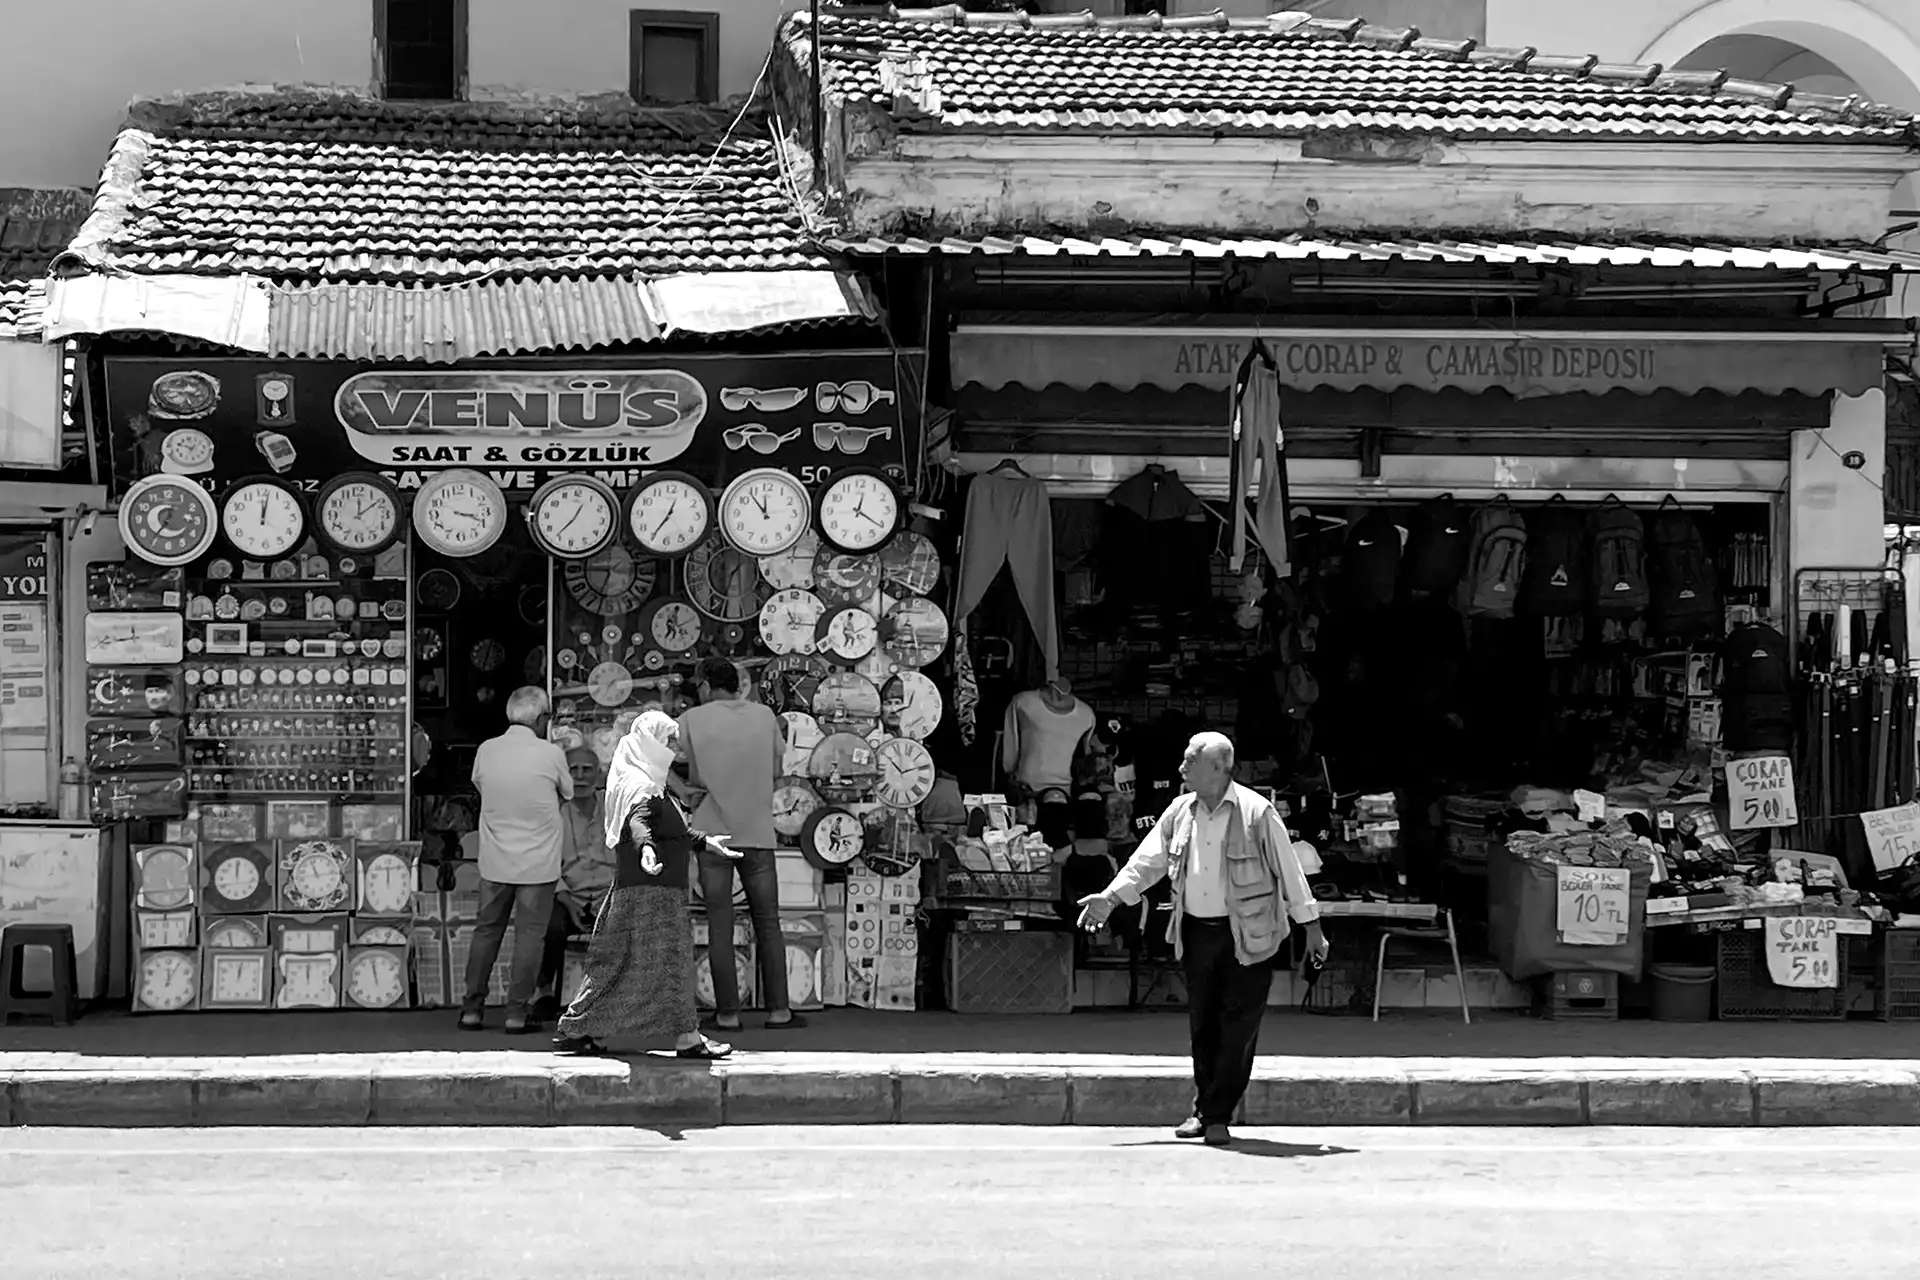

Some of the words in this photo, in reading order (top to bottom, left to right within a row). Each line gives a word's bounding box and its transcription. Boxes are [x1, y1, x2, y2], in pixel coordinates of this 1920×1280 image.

[1175, 343, 1278, 374] ATAK
[1286, 344, 1377, 382] ÇORAP
[1385, 345, 1403, 375] &
[1426, 345, 1543, 384] ÇAMAŞIR
[353, 380, 681, 429] VENÜS
[392, 446, 472, 462] SAAT
[484, 446, 509, 462] &
[520, 442, 652, 462] GÖZLÜK
[489, 470, 536, 489] VE
[855, 478, 866, 488] 12
[653, 487, 662, 497] 11
[666, 483, 678, 494] 12
[762, 482, 774, 492] 12
[842, 483, 851, 493] 11
[244, 491, 253, 502] 11
[739, 495, 750, 505] 10
[786, 496, 793, 506] 2
[832, 493, 843, 503] 10
[878, 492, 887, 502] 2
[234, 501, 246, 512] 10
[283, 500, 291, 510] 2
[642, 497, 653, 507] 10
[690, 499, 697, 508] 2
[636, 509, 644, 519] 9
[790, 508, 798, 519] 3
[826, 506, 834, 516] 9
[883, 505, 892, 516] 3
[229, 514, 238, 525] 9
[289, 513, 297, 523] 3
[694, 511, 702, 522] 3
[687, 525, 694, 534] 4
[785, 523, 792, 533] 4
[830, 520, 838, 530] 8
[235, 527, 244, 538] 8
[285, 527, 293, 536] 4
[747, 531, 755, 541] 7
[841, 529, 848, 539] 7
[868, 528, 877, 538] 5
[247, 536, 255, 546] 7
[276, 536, 285, 546] 5
[662, 536, 671, 546] 6
[760, 534, 768, 545] 6
[1744, 778, 1787, 792] TANE
[1136, 815, 1156, 829] BTS
[1775, 941, 1820, 953] TANE
